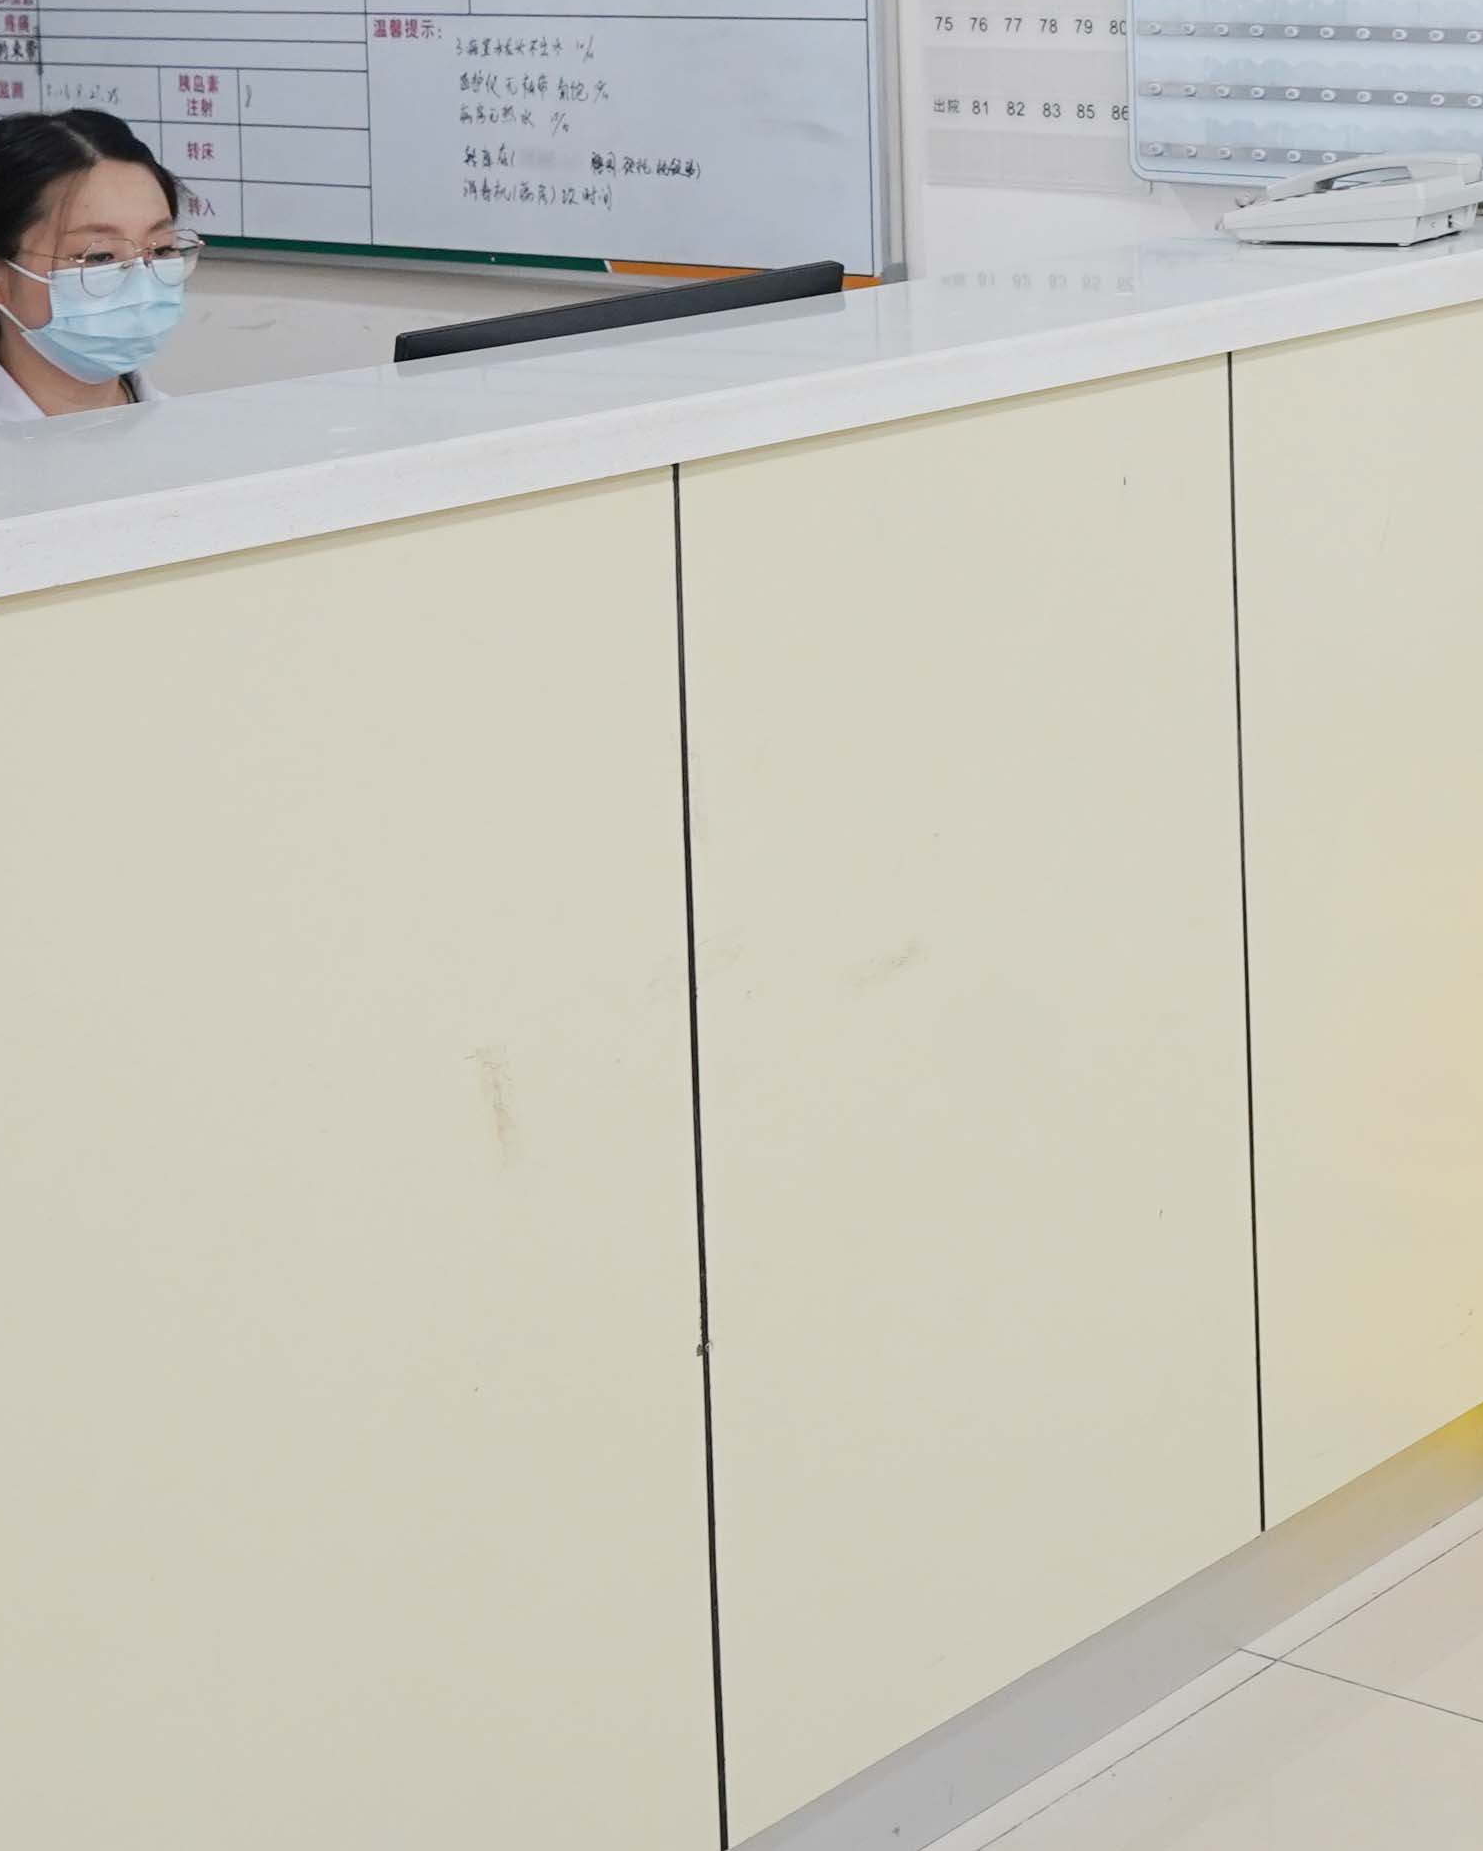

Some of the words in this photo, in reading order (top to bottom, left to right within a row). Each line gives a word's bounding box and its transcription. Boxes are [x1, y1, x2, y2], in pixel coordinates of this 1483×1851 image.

[934, 16, 954, 32] 75
[969, 17, 988, 32] 76
[1004, 17, 1023, 33] 77
[1039, 18, 1058, 34] 78
[1075, 19, 1093, 35] 79
[186, 98, 213, 117] 注射
[933, 98, 961, 115] 出院
[971, 100, 989, 116] 81
[1006, 101, 1026, 117] 82
[1042, 102, 1062, 118] 83
[1076, 104, 1096, 119] 85
